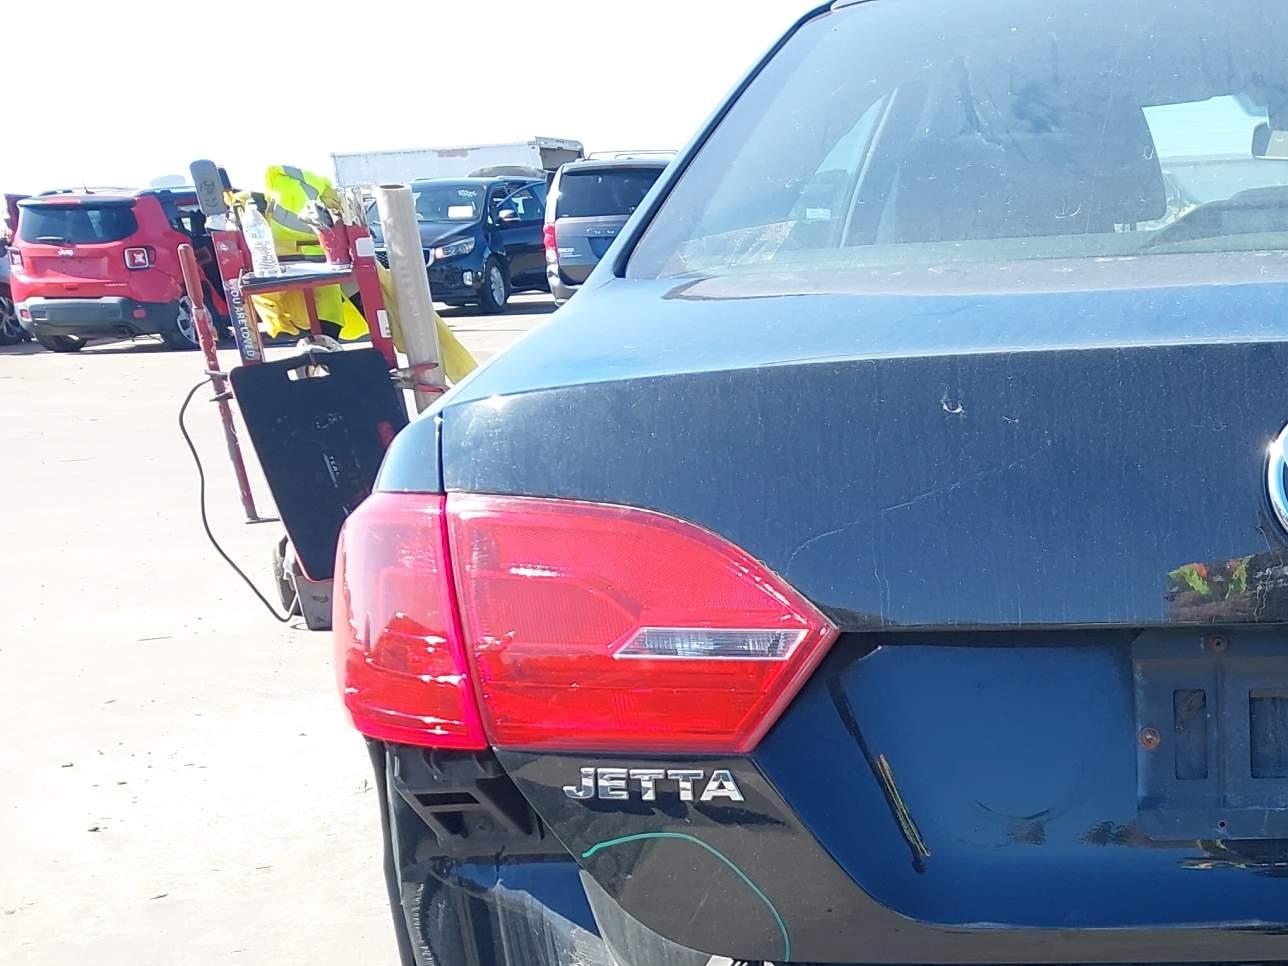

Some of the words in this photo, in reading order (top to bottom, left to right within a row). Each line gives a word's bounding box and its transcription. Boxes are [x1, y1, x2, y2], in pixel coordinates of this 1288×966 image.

[234, 306, 246, 325] ARE
[240, 327, 256, 357] LOVED
[562, 767, 745, 801] JETTA
